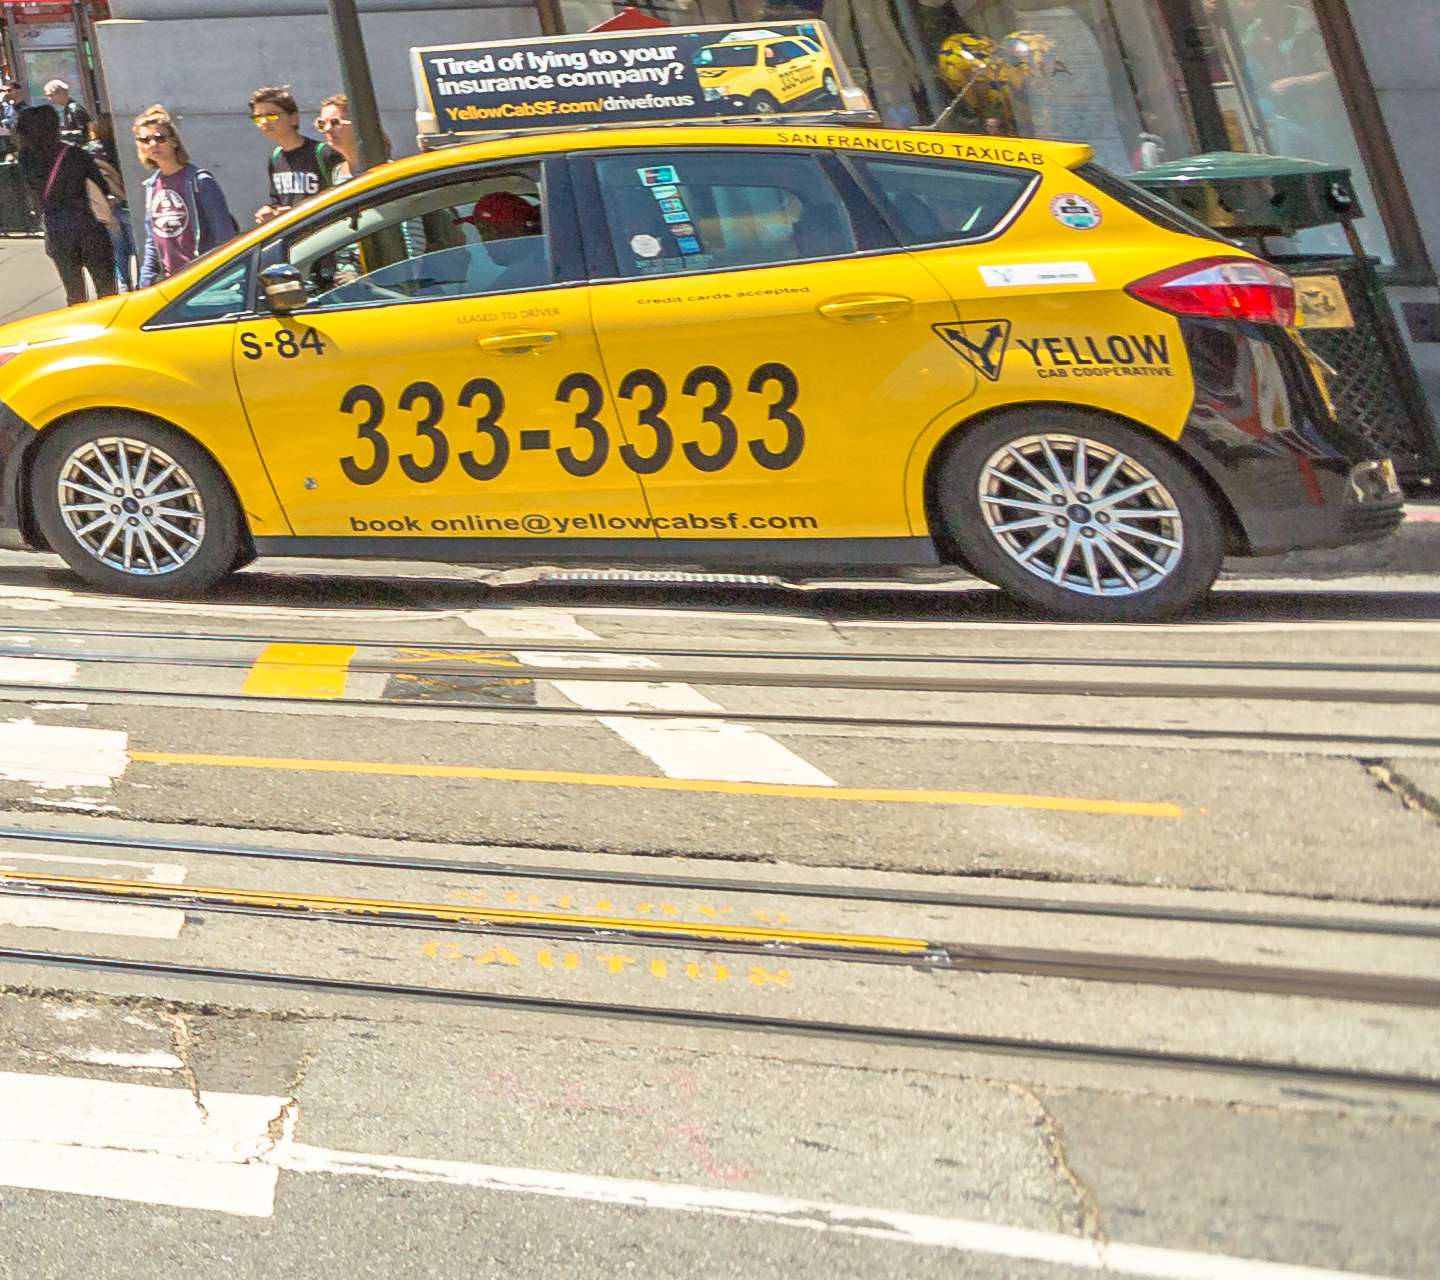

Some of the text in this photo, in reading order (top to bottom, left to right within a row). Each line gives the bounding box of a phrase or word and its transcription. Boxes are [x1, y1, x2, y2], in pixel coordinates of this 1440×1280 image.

[430, 45, 678, 76] Tired of lying to your
[436, 62, 685, 96] insurance company?
[445, 94, 695, 121] YellowCabSF.com/driveforus
[777, 131, 1046, 167] SAN FRANCISCO TAXICAB
[637, 286, 811, 306] credit cards accepted
[456, 306, 562, 324] LEASED TO DRIVER
[239, 325, 326, 361] S-84
[1017, 334, 1170, 369] YELLOW
[1036, 366, 1174, 380] CAB COOPERATIVE
[338, 361, 805, 487] 333-3333
[349, 510, 819, 536] book online@yellowcabsf.com
